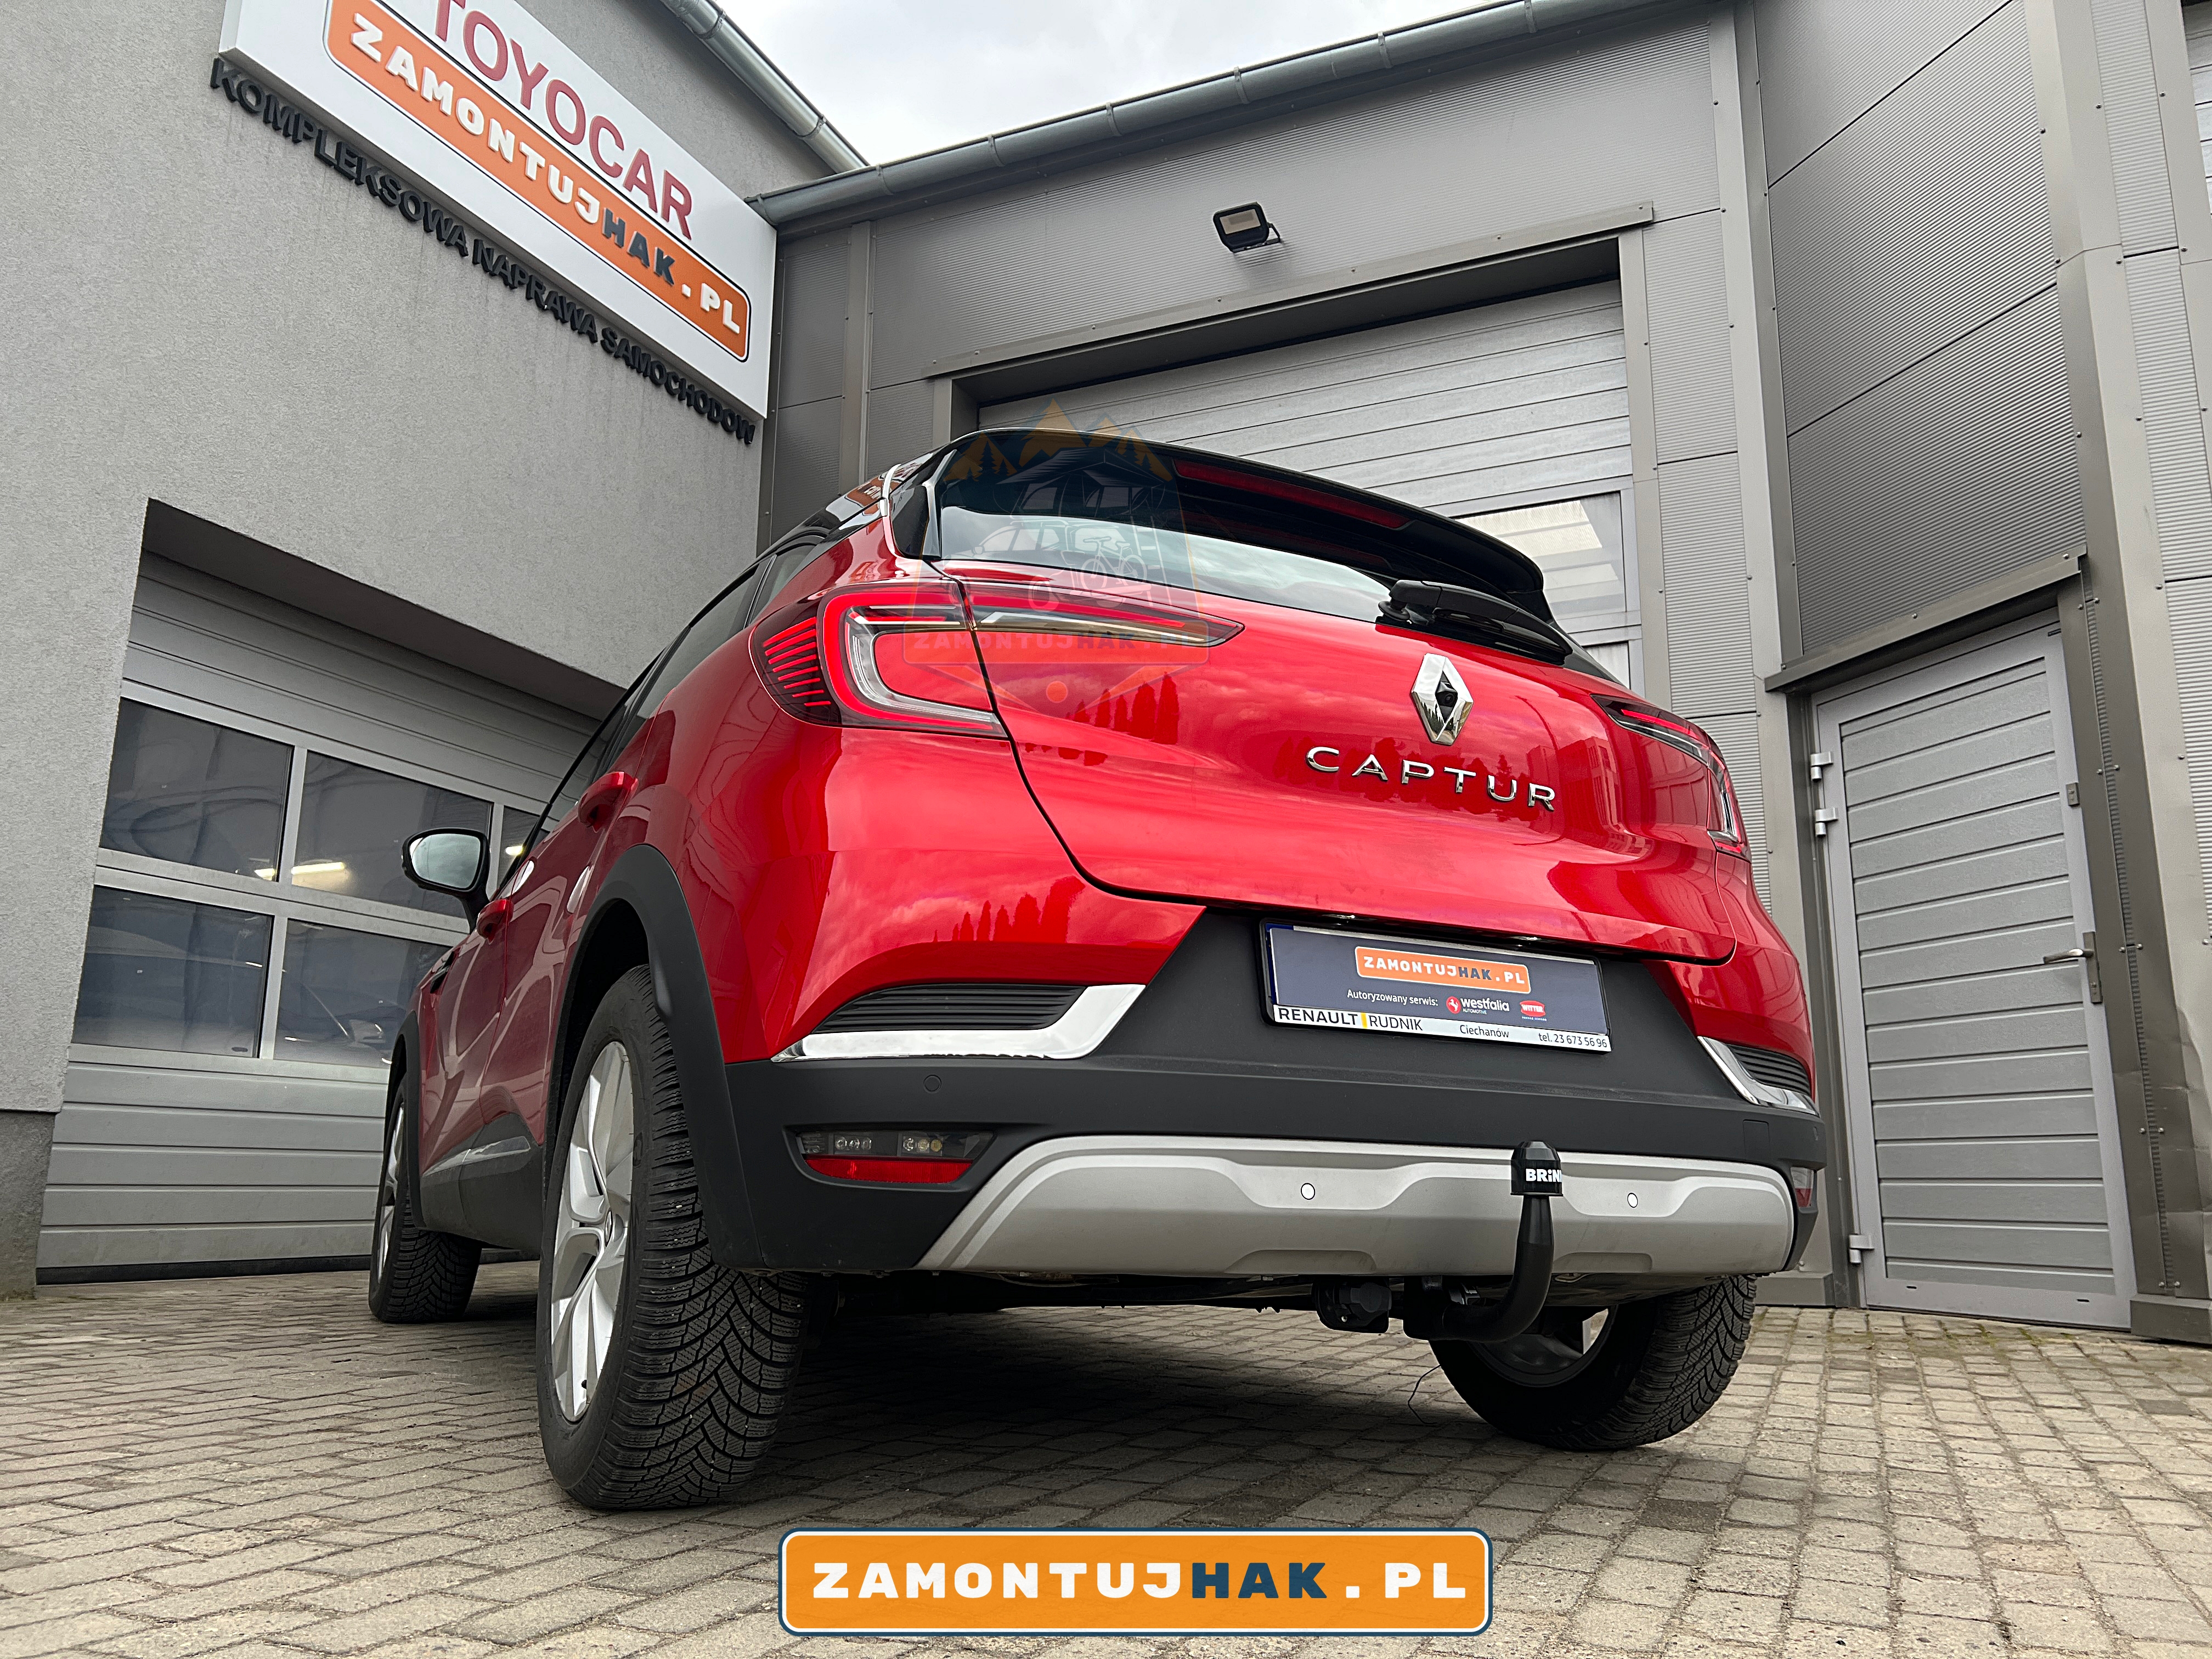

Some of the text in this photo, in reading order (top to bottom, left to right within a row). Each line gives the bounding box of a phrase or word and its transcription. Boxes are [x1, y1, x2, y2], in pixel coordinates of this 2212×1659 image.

[436, 0, 692, 241] TOYOCAR
[210, 58, 469, 257] KOMPLEKSOWA
[472, 239, 598, 343] NAPRAWA
[1306, 746, 1555, 811] CAPTUR
[1347, 989, 1438, 1006] Autoryzowany serwis:
[1460, 997, 1510, 1012] westfalia
[1521, 1004, 1544, 1013] WITTER
[1278, 1007, 1423, 1031] RENAULT RUDNIK
[1460, 1024, 1509, 1038] Ciechanów
[1538, 1032, 1607, 1048] tel. 23 673 56 96
